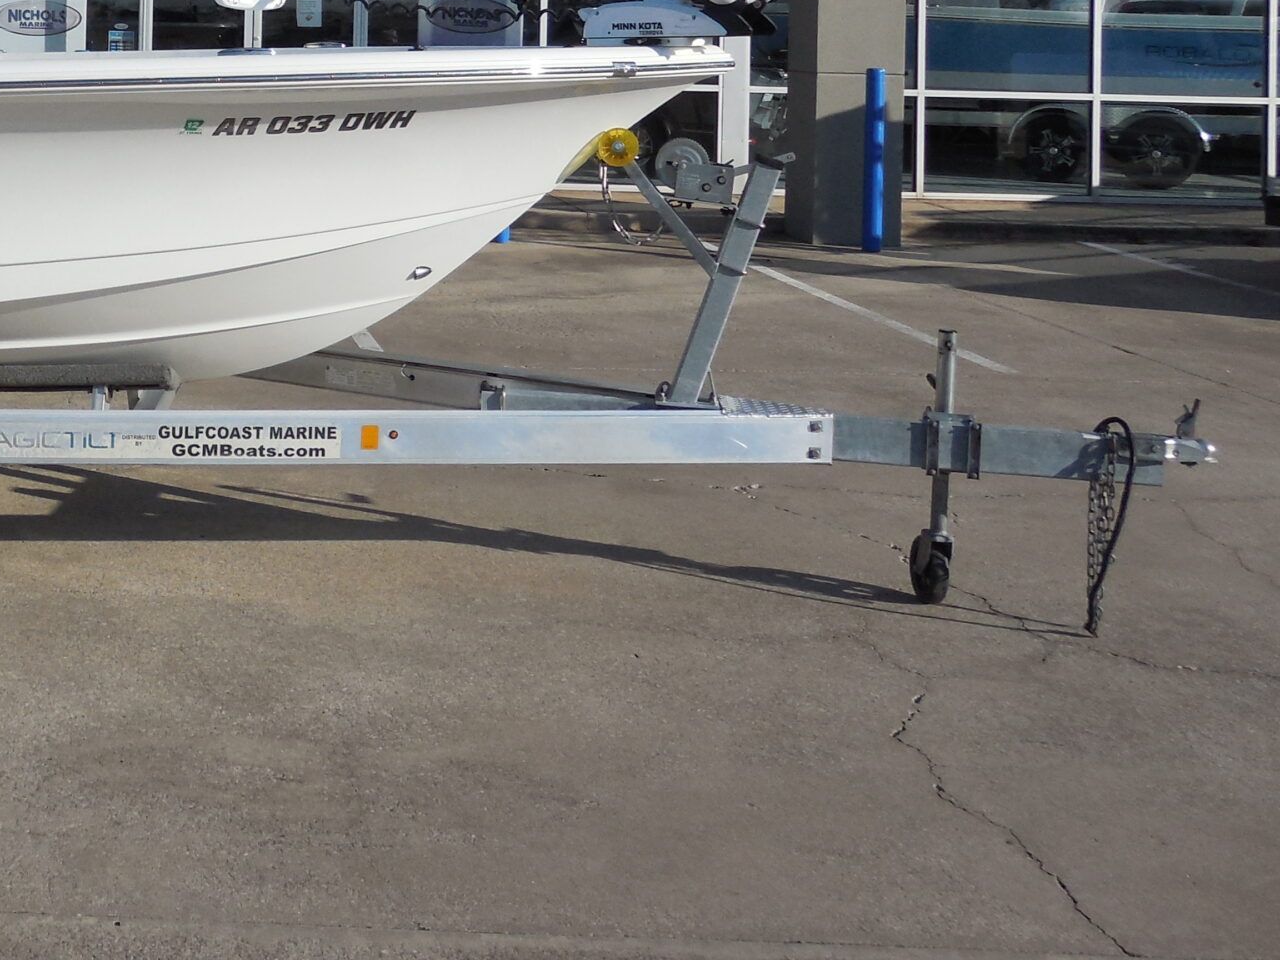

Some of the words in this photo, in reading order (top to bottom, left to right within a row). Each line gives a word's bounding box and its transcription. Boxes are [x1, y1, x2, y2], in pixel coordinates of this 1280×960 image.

[7, 8, 67, 24] NICHOLS
[639, 22, 663, 30] KOTA
[212, 117, 261, 136] AR
[266, 114, 336, 134] 033
[339, 110, 417, 132] DWH
[158, 425, 263, 440] GULFCOAST
[270, 426, 337, 440] MARINE
[171, 443, 326, 458] GCMBoats.com
